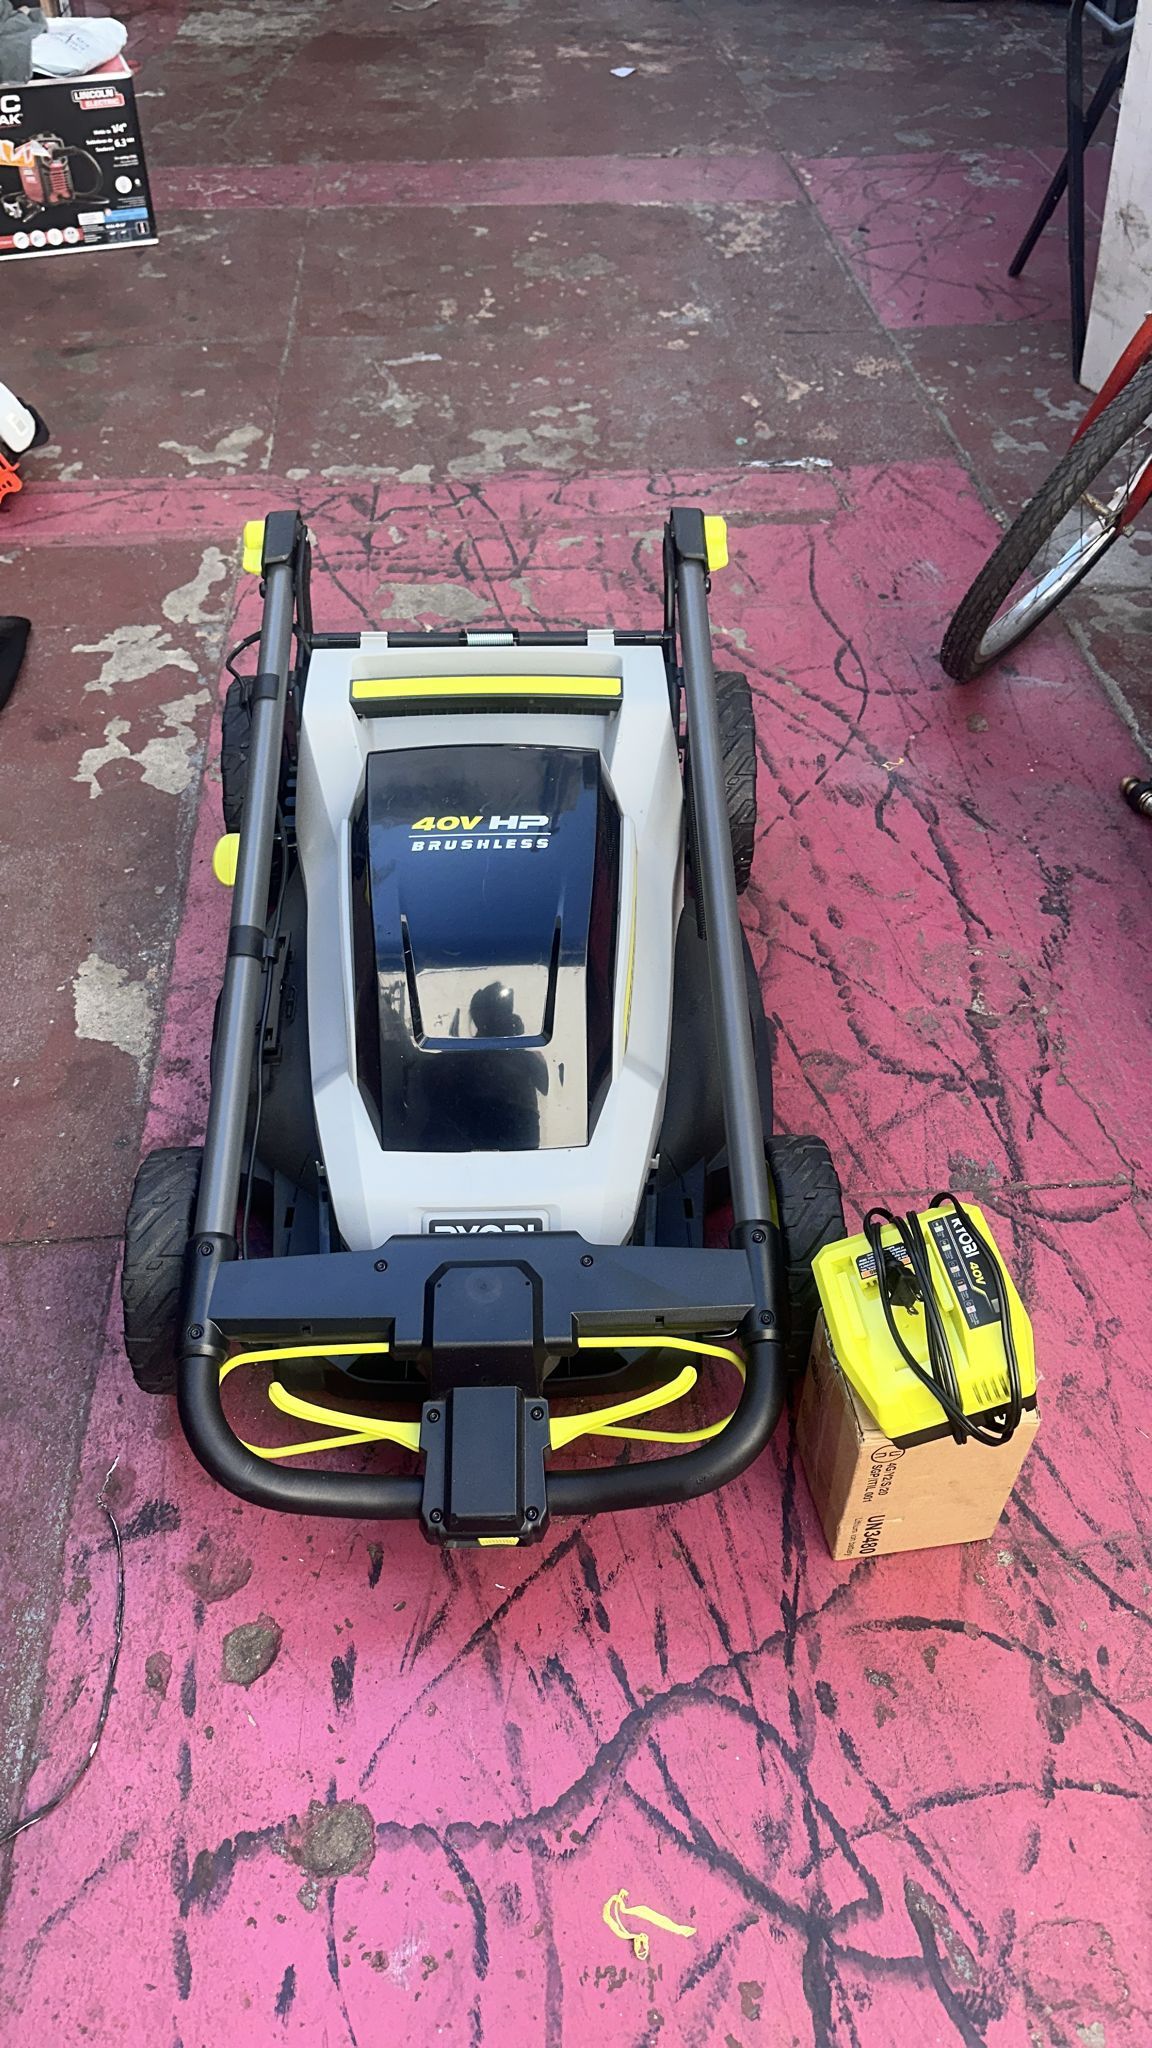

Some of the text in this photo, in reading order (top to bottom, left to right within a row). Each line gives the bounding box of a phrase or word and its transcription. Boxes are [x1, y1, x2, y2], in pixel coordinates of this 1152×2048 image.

[74, 88, 114, 100] LINCOLN
[85, 98, 120, 108] ELECTRIC
[411, 815, 549, 831] 40V HP
[411, 838, 549, 852] BRUSHLESS
[969, 1261, 987, 1285] 40V
[859, 1514, 886, 1555] UN3480
